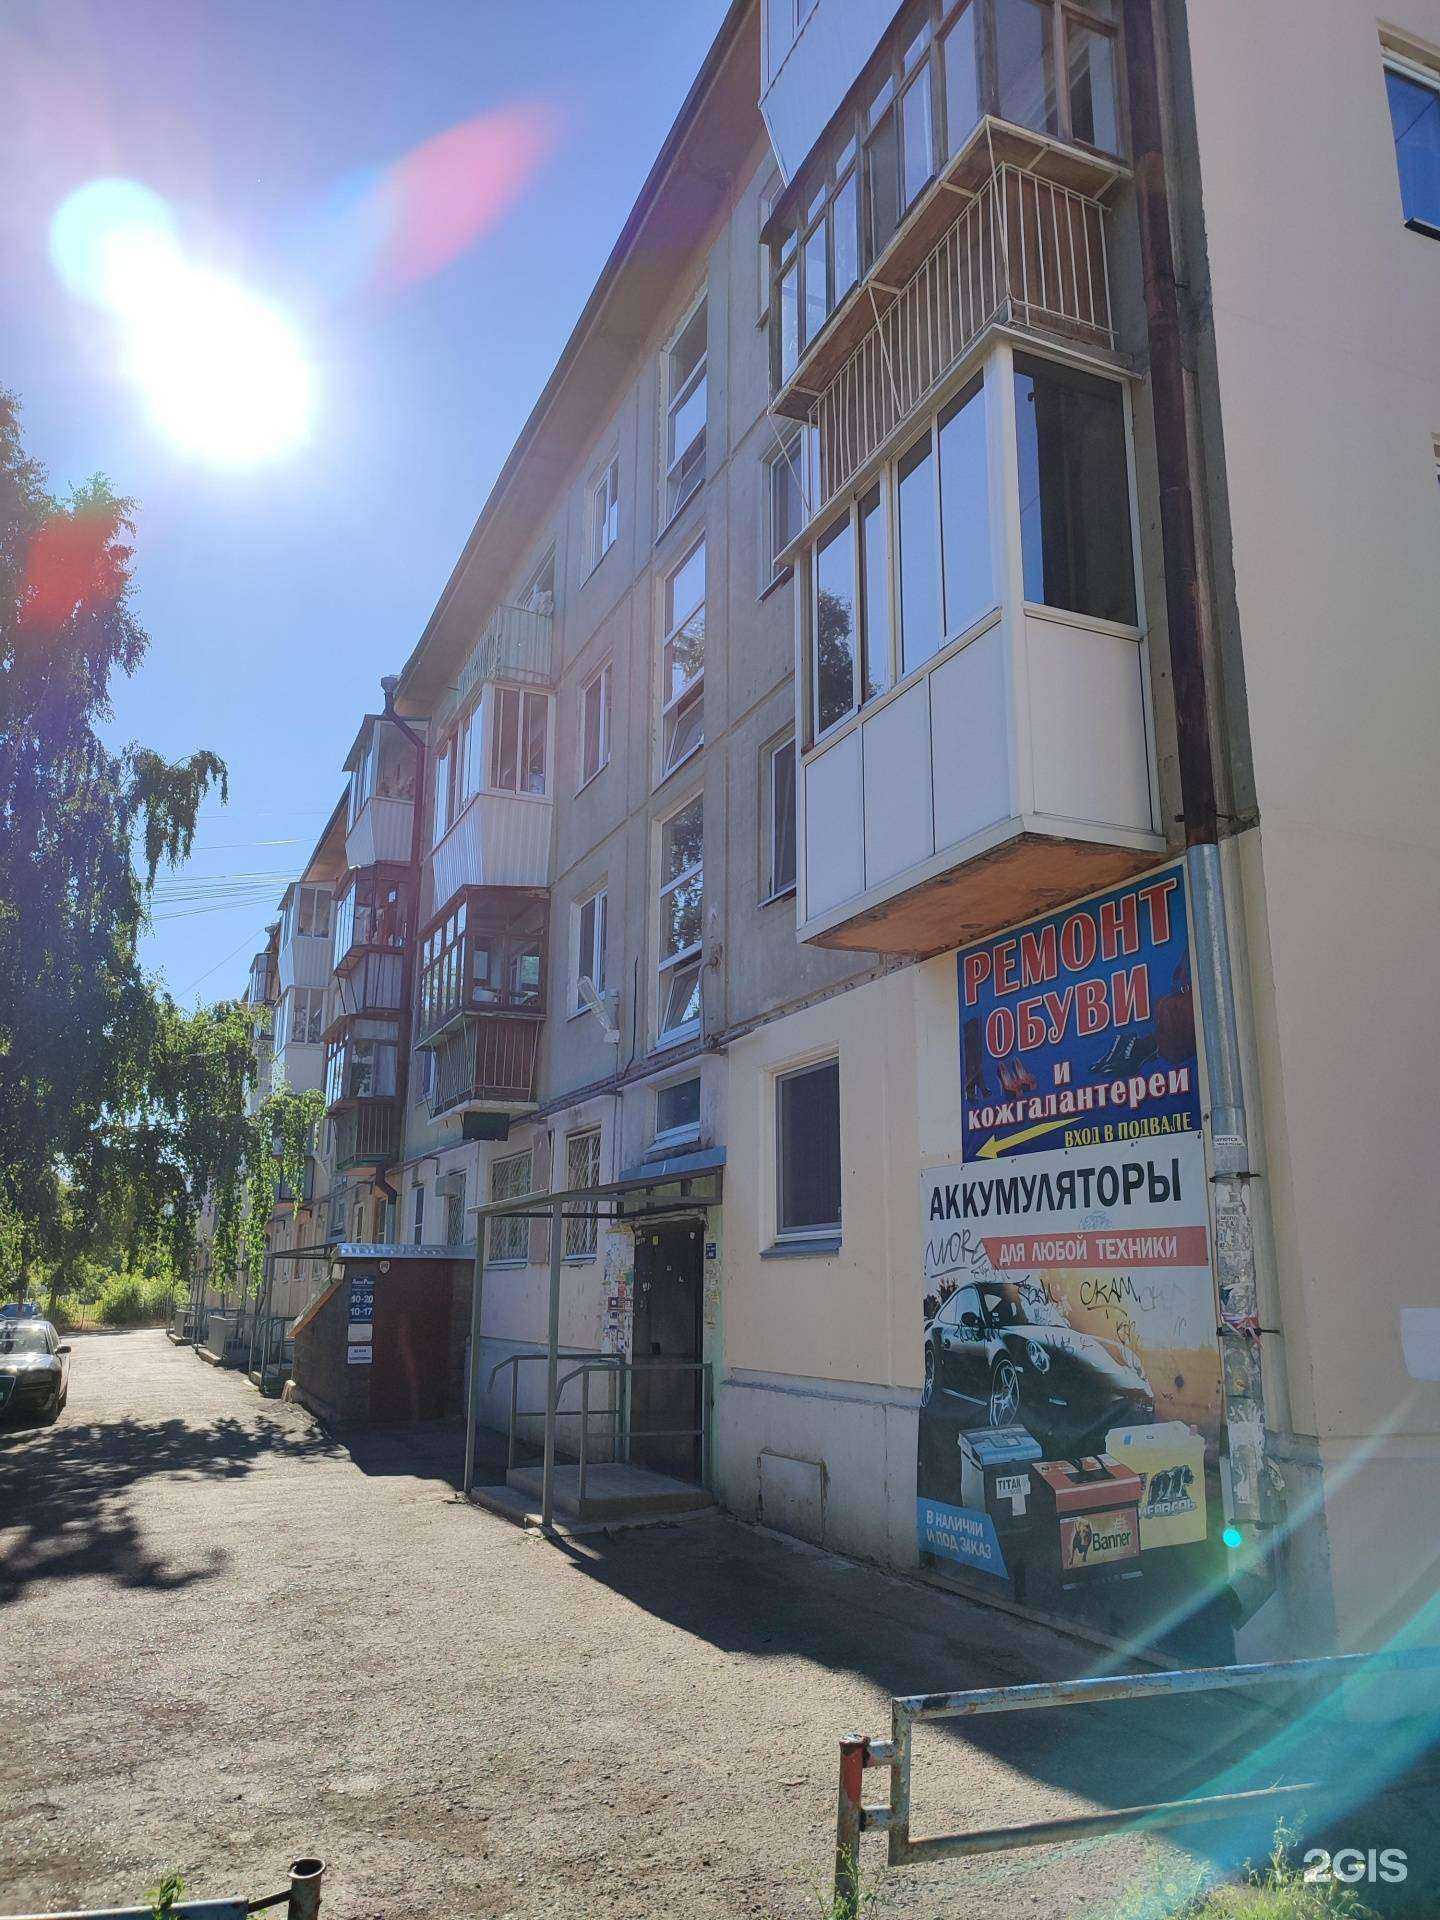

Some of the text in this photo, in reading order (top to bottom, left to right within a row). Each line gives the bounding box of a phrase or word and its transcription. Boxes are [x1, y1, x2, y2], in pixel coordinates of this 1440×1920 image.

[964, 877, 1177, 1006] РЕМОНТ
[985, 963, 1150, 1059] ОБУВИ
[1053, 1061, 1072, 1085] и
[968, 1067, 1191, 1131] кожгалантереи
[1064, 1111, 1193, 1148] ВХОД В ПОДВАЛЕ
[929, 1157, 1182, 1222] АККУМУЛЯТОРЫ
[999, 1233, 1178, 1266] ДЛЯ ЛЮБОЙ ТЕХНИКИ
[350, 1307, 373, 1316] 10-17
[926, 1510, 984, 1538] В НАЛИЧИИ
[927, 1529, 992, 1560] И ПОД ЗАКАЗ
[1092, 1531, 1131, 1552] Banner
